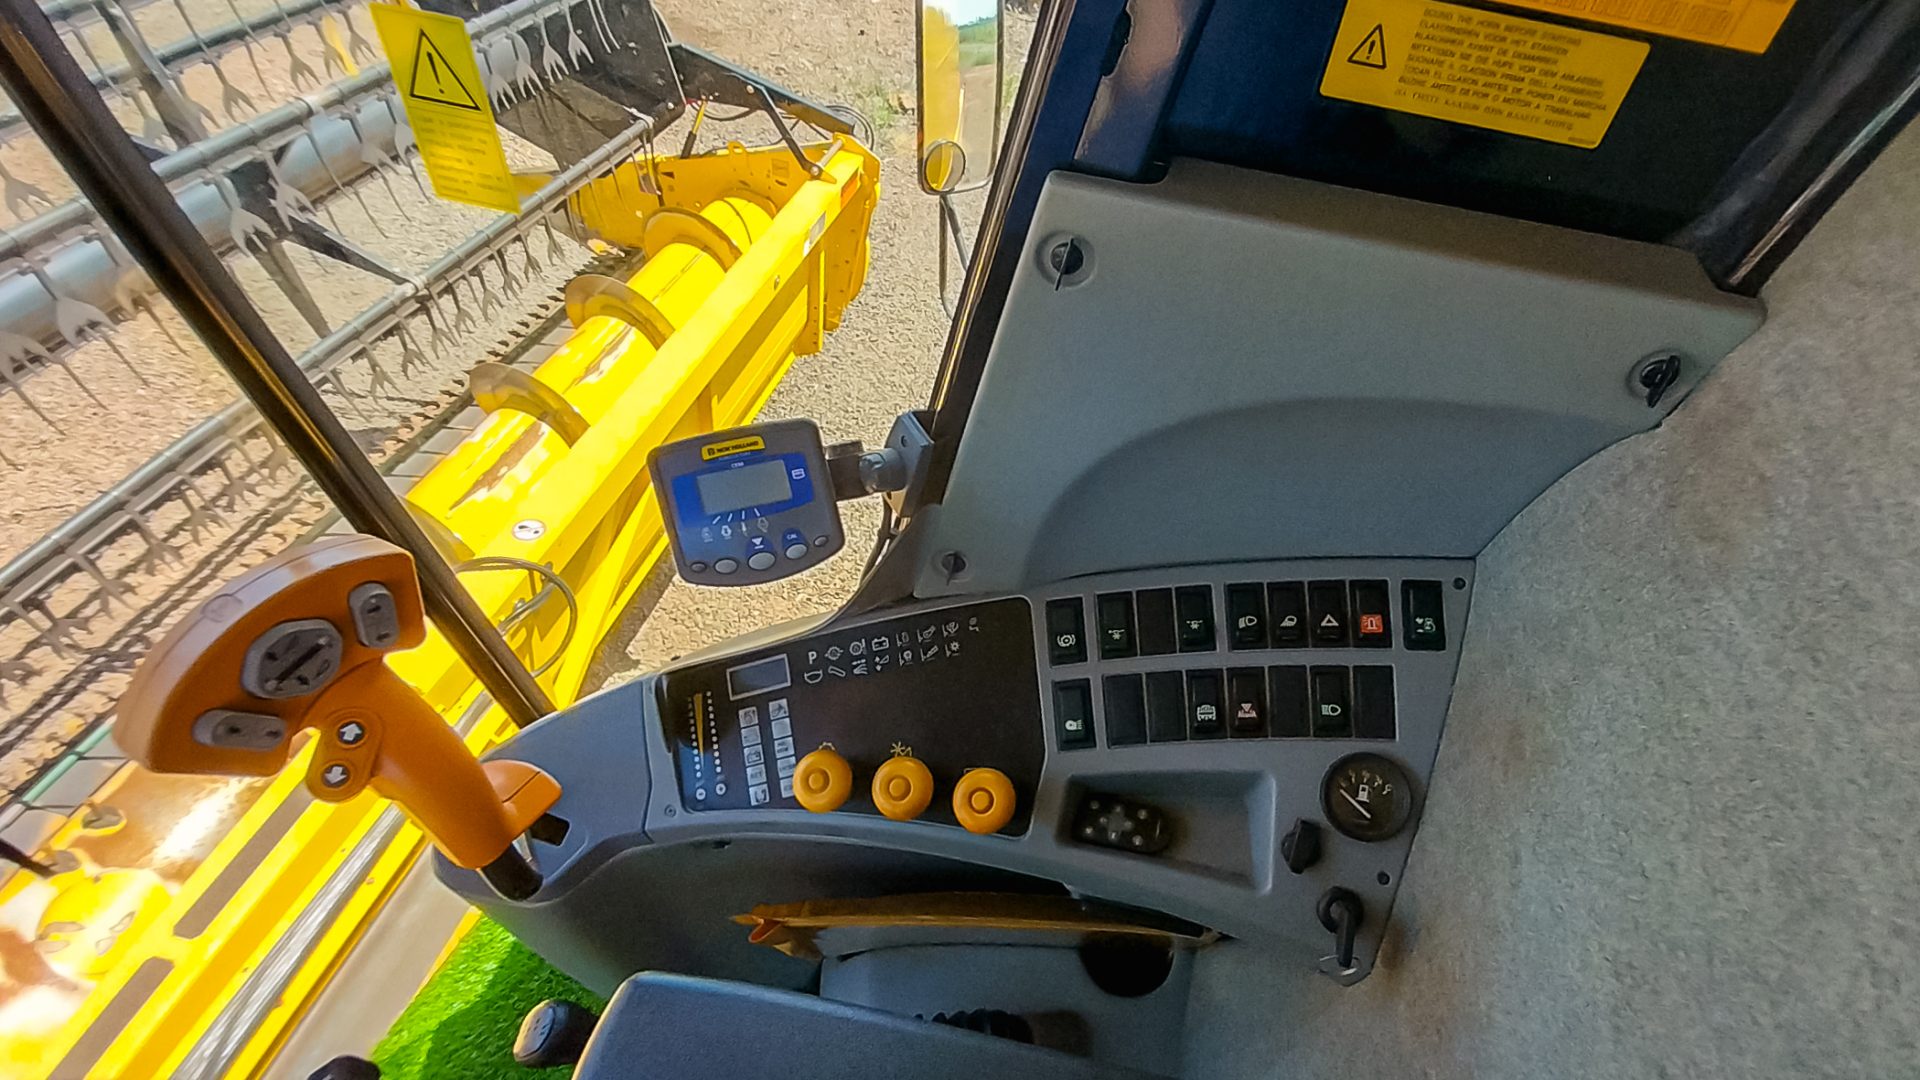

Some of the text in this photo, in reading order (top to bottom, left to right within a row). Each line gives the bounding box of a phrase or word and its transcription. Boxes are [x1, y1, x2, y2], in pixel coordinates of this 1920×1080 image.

[1503, 23, 1537, 37] BEFORE
[1467, 41, 1494, 53] AVANT
[732, 441, 759, 451] HOLLAND
[808, 651, 817, 664] P
